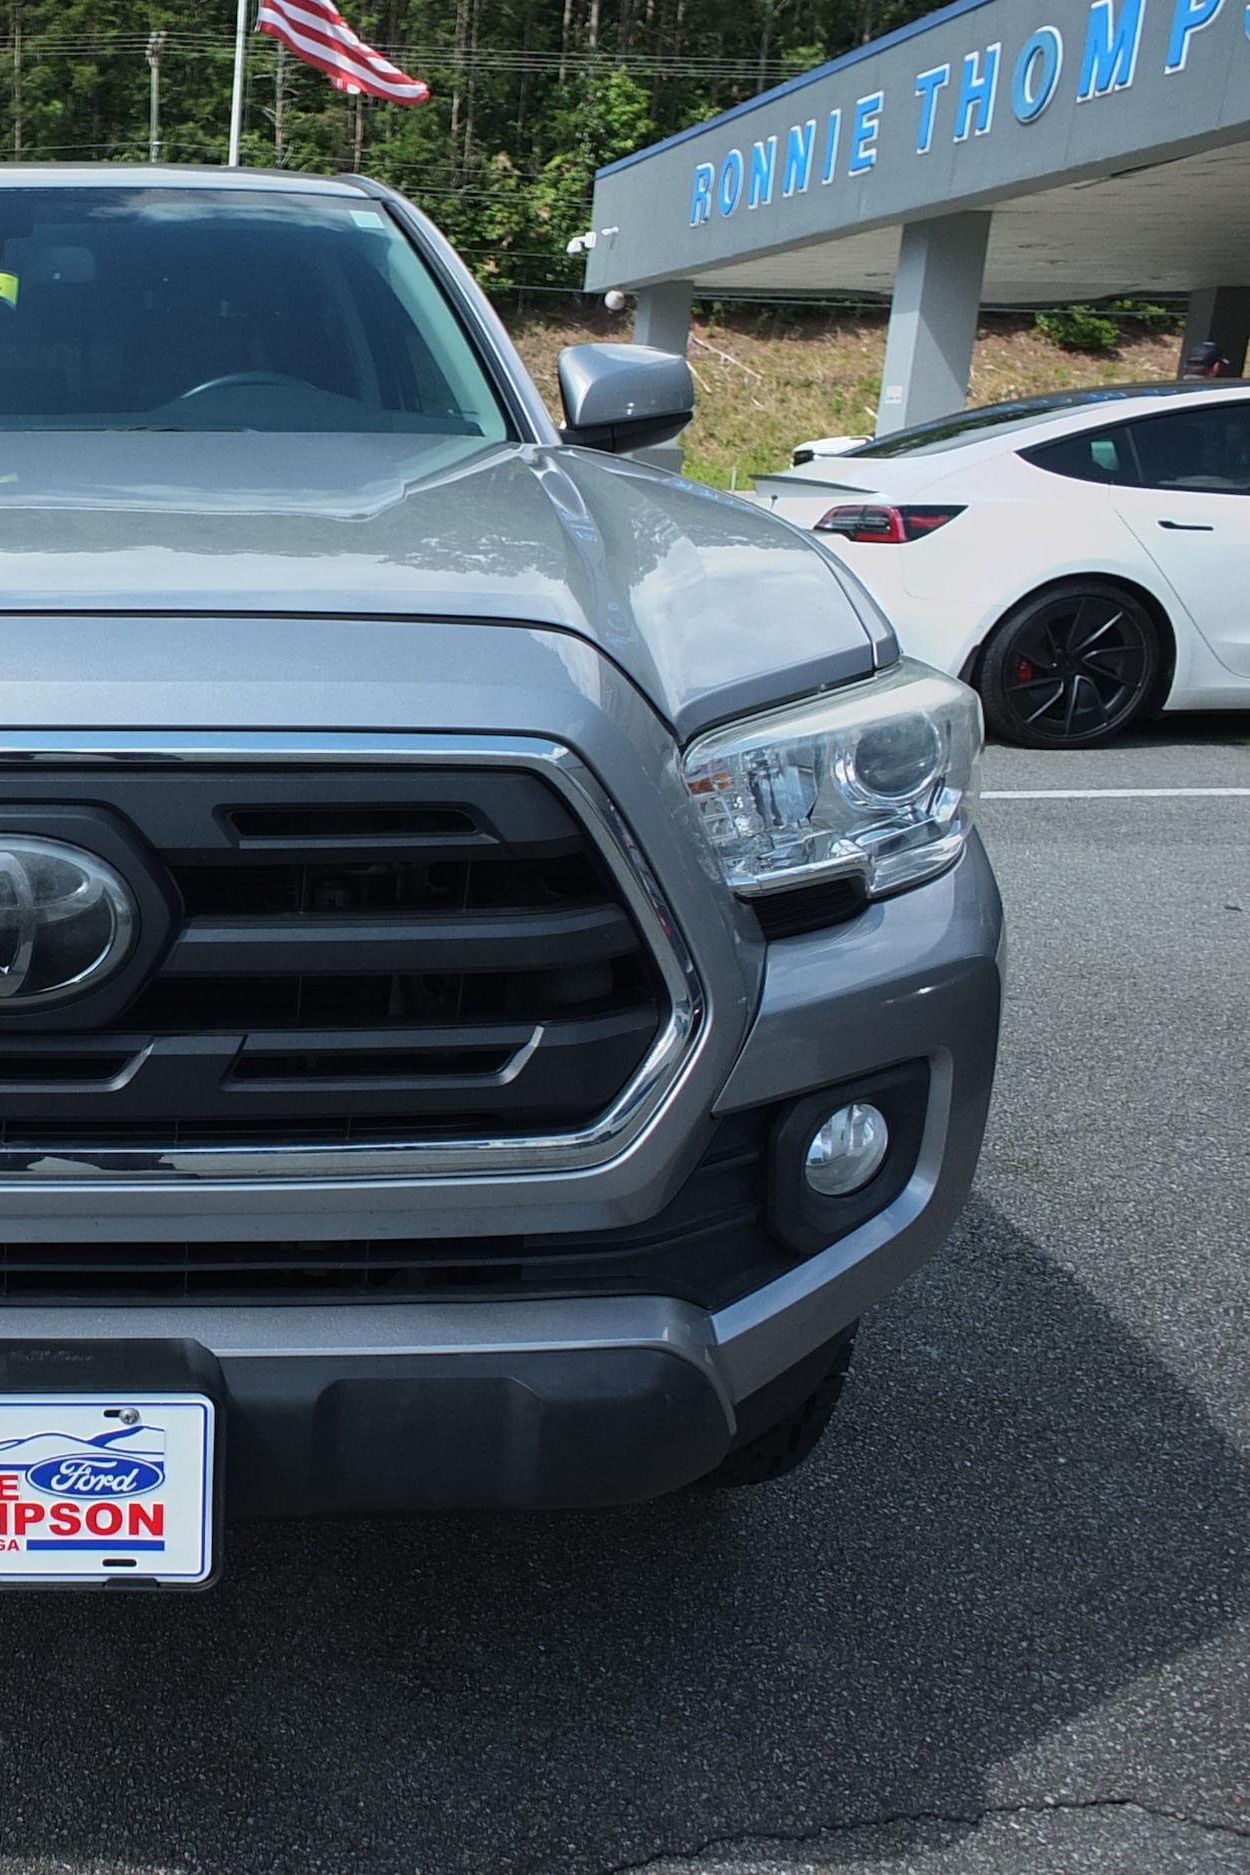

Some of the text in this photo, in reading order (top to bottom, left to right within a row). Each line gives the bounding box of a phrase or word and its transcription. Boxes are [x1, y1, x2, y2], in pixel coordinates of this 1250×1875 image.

[688, 0, 1250, 228] RONNIE THOMP
[49, 1458, 137, 1494] Ford
